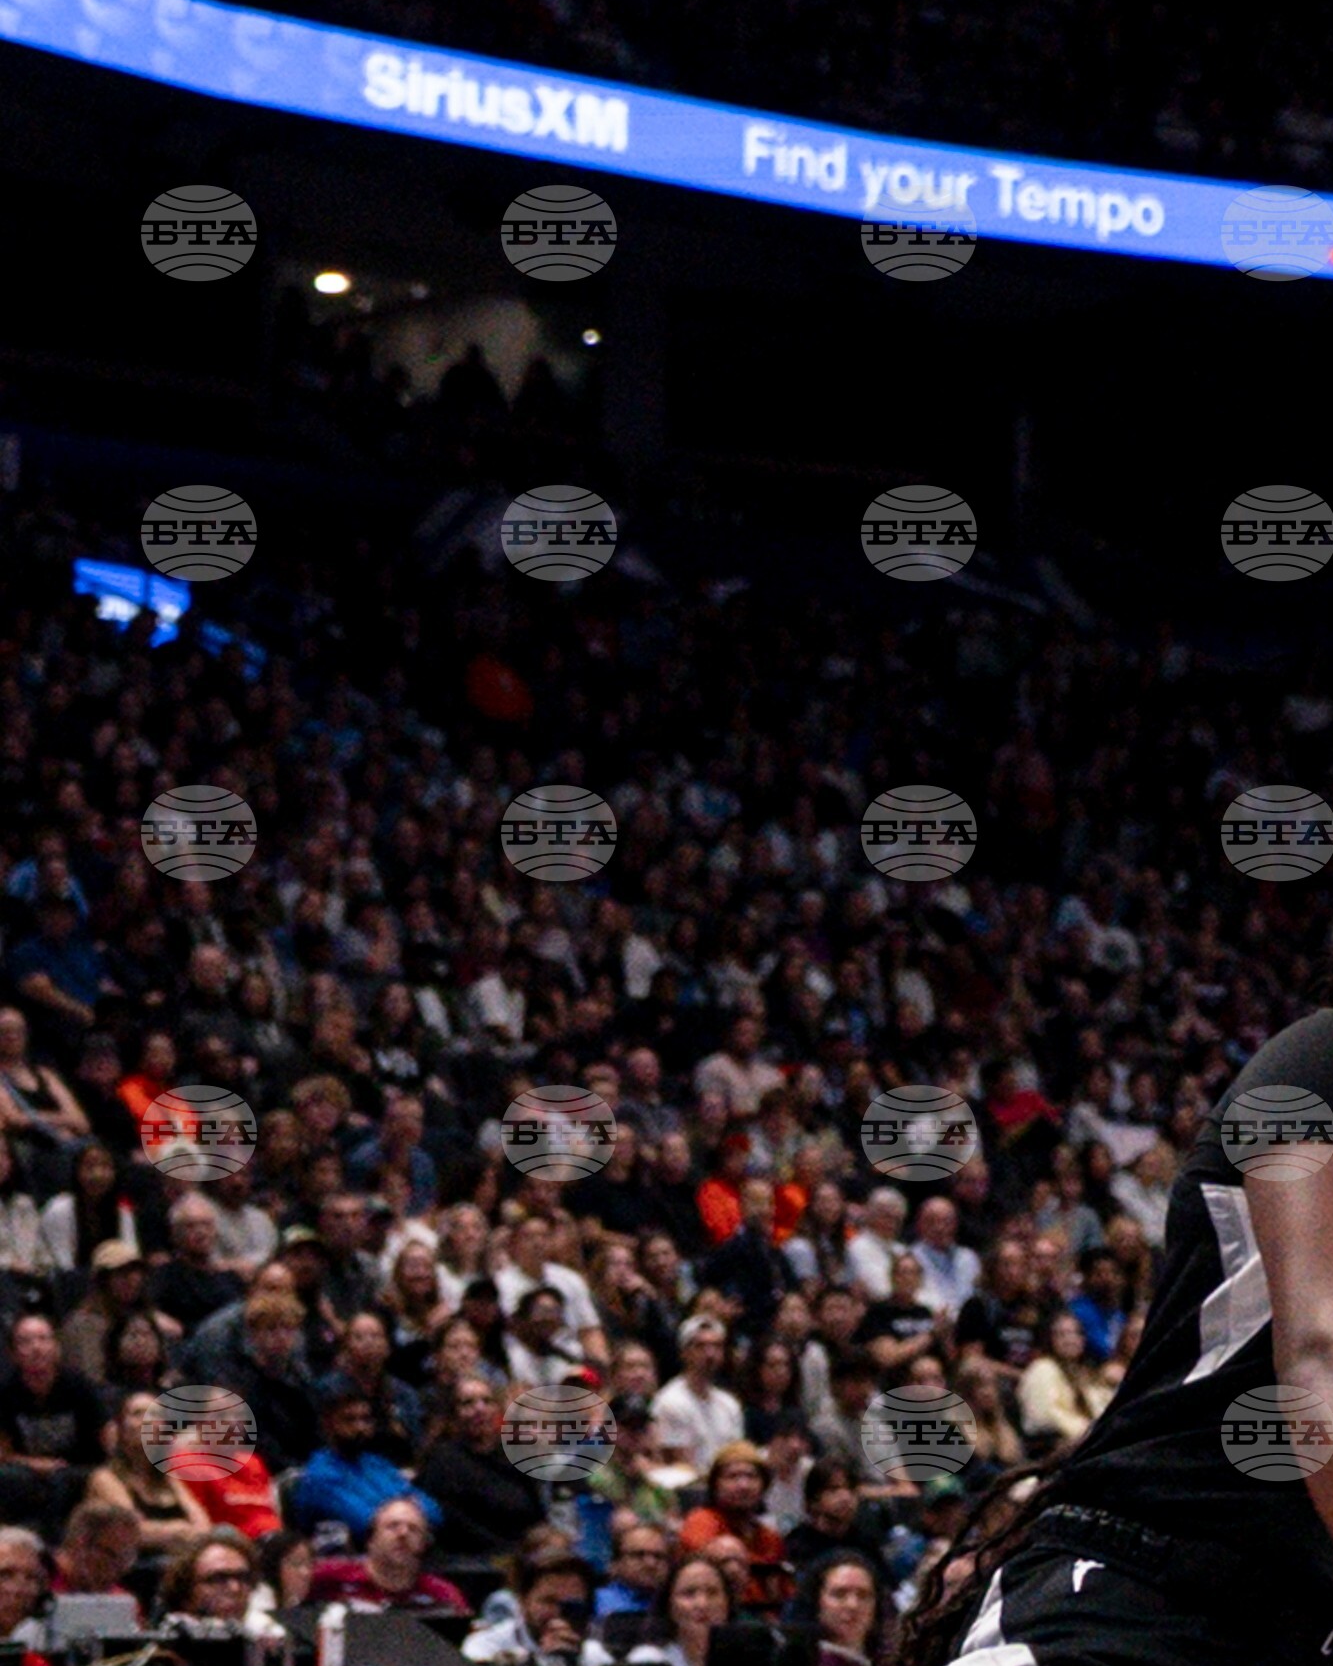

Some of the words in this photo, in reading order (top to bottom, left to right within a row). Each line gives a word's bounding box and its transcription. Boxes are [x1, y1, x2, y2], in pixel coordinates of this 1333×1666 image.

[362, 51, 629, 152] SiriusXM
[742, 123, 848, 193] Find
[862, 160, 976, 216] your
[992, 163, 1166, 239] Tempo
